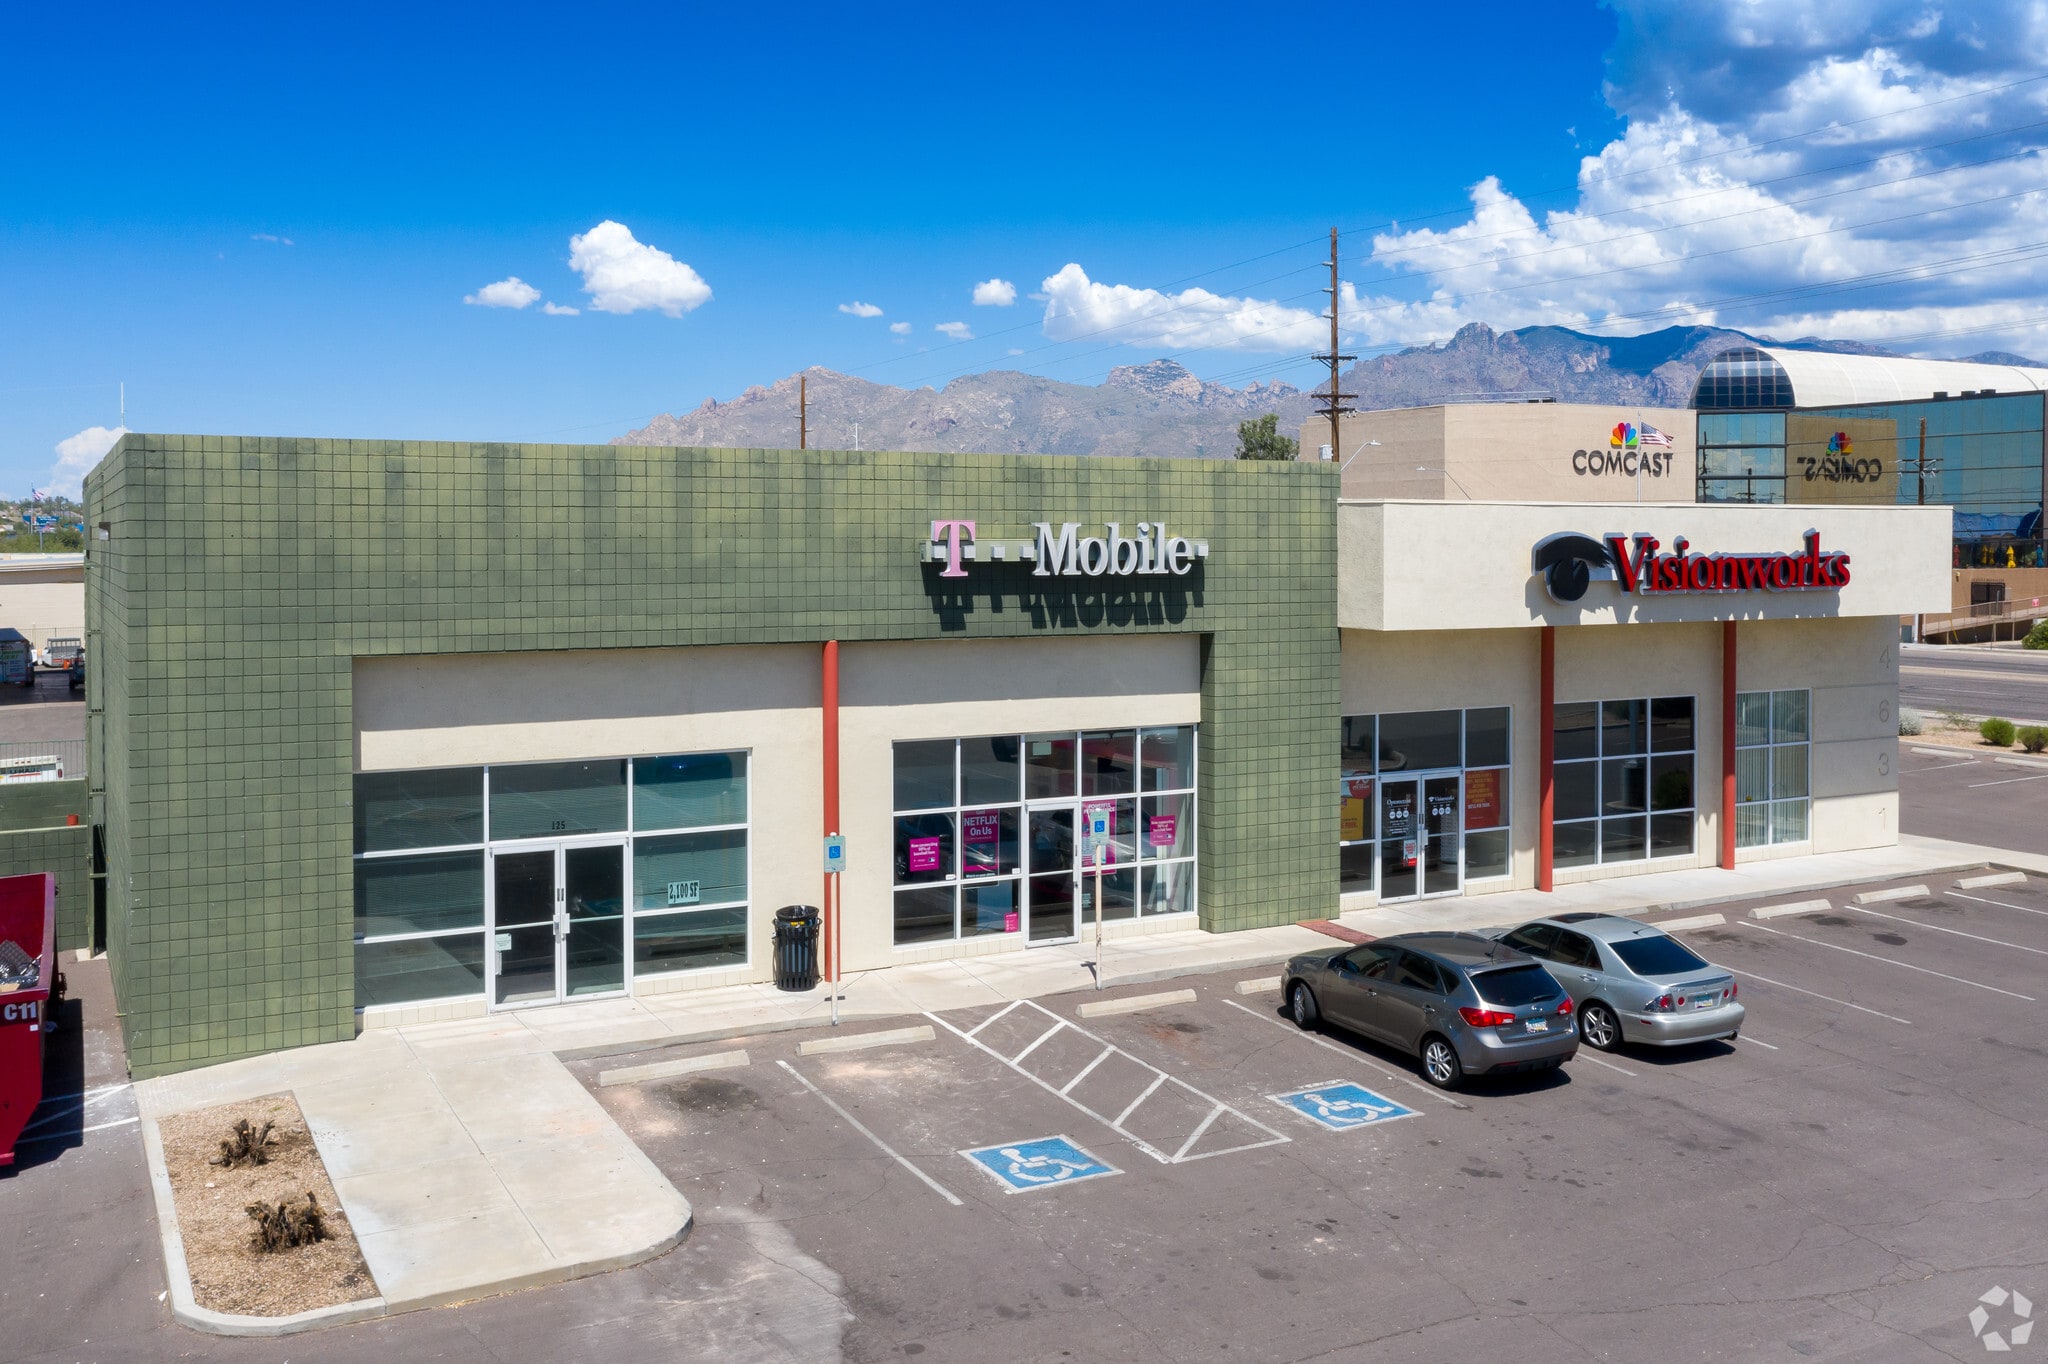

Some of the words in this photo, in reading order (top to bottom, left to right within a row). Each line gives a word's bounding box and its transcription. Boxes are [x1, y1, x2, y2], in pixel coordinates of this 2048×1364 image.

[1572, 450, 1674, 477] COMCAST
[1604, 530, 1850, 593] Visionworks
[552, 821, 565, 830] 125
[964, 815, 997, 826] NETFLIX
[970, 827, 981, 836] On
[982, 826, 992, 835] Us
[669, 883, 689, 902] 2,100
[690, 881, 698, 897] SF
[4, 1001, 37, 1020] C11
